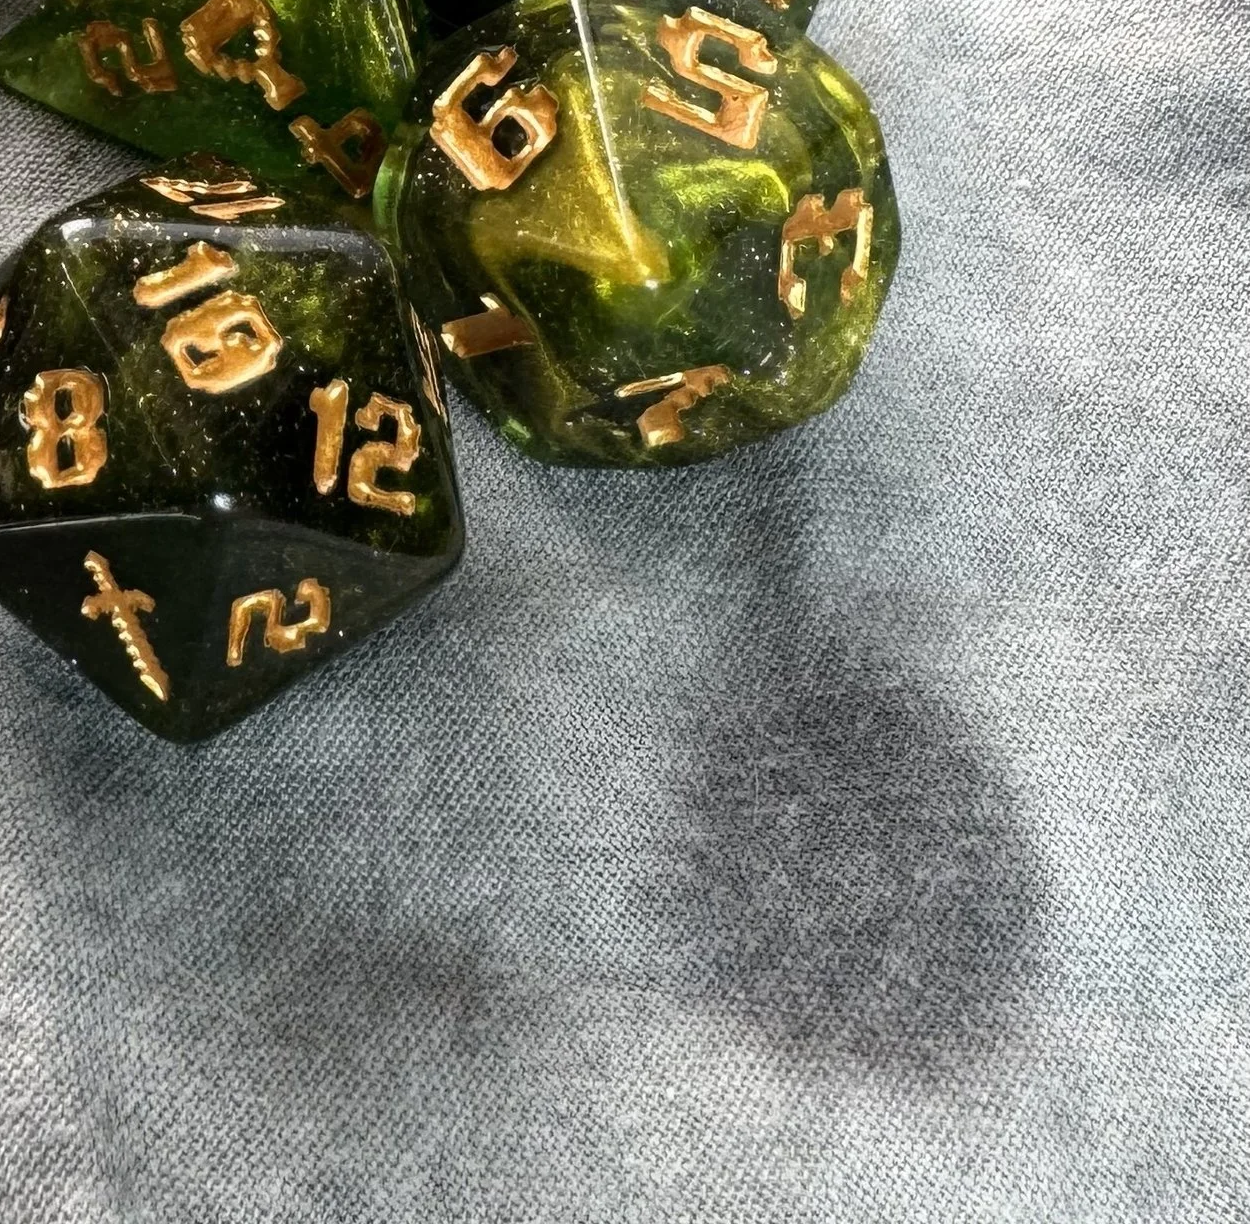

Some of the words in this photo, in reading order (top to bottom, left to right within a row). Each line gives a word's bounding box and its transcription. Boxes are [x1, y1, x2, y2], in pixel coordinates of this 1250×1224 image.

[76, 16, 179, 97] 2
[640, 5, 780, 152] 5
[778, 186, 876, 320] 3
[23, 367, 110, 489] 8
[308, 378, 422, 517] 12
[226, 577, 331, 667] 2
